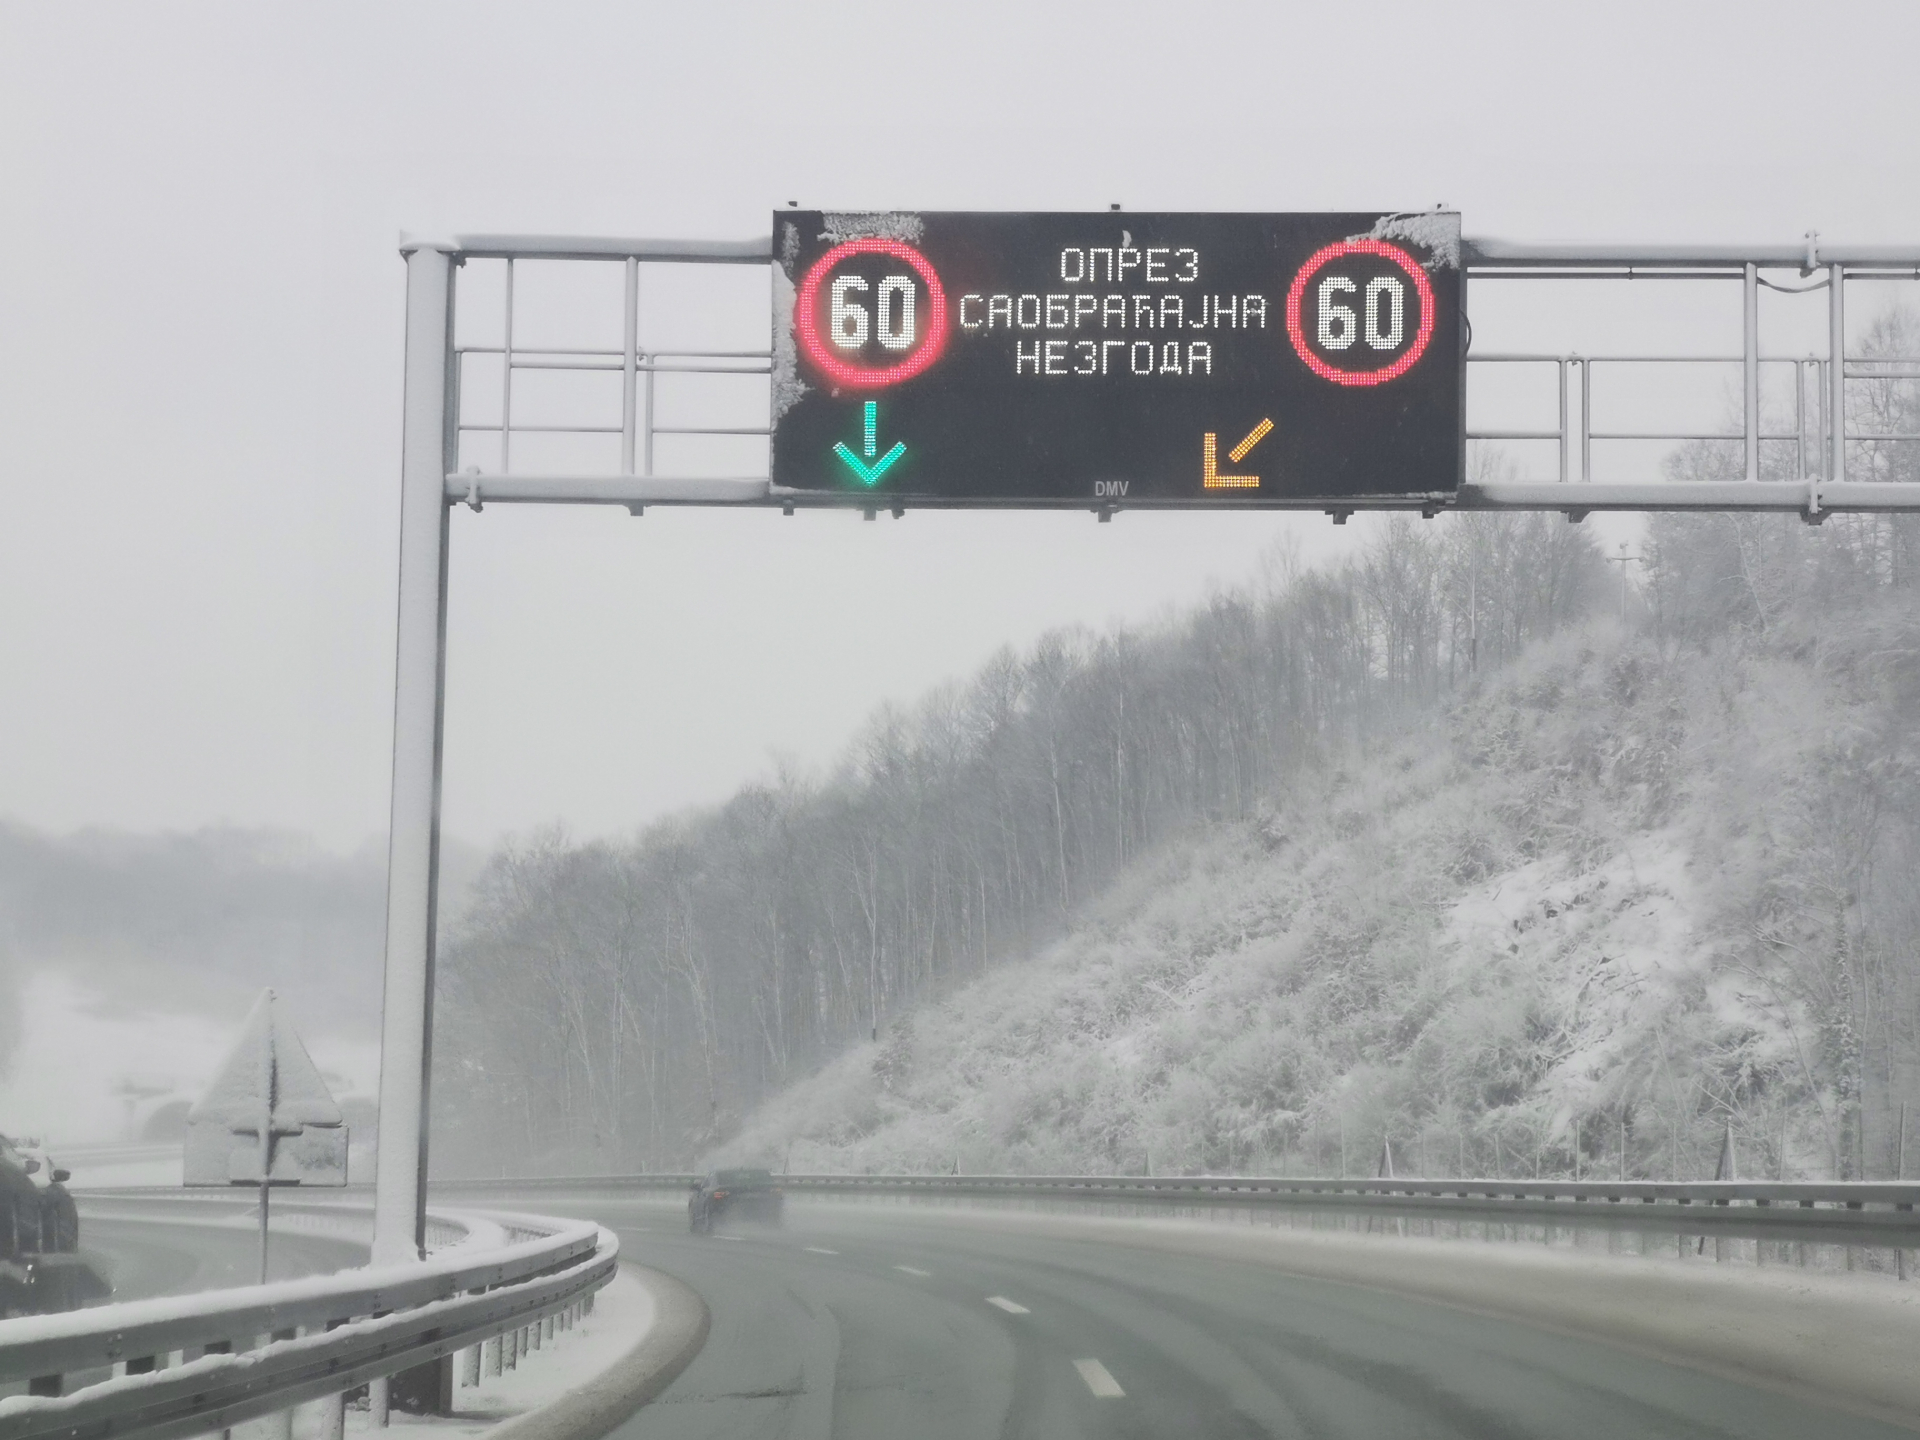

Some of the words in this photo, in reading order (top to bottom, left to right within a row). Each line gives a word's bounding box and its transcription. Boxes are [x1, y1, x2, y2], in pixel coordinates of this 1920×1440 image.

[1060, 247, 1199, 282] ОПРЕЗ
[830, 275, 916, 351] 60
[959, 294, 1266, 328] САОБРАЋАЈНА
[1317, 275, 1405, 351] 60
[1016, 340, 1212, 375] НЕЗГОДА
[1095, 480, 1129, 497] DMV
